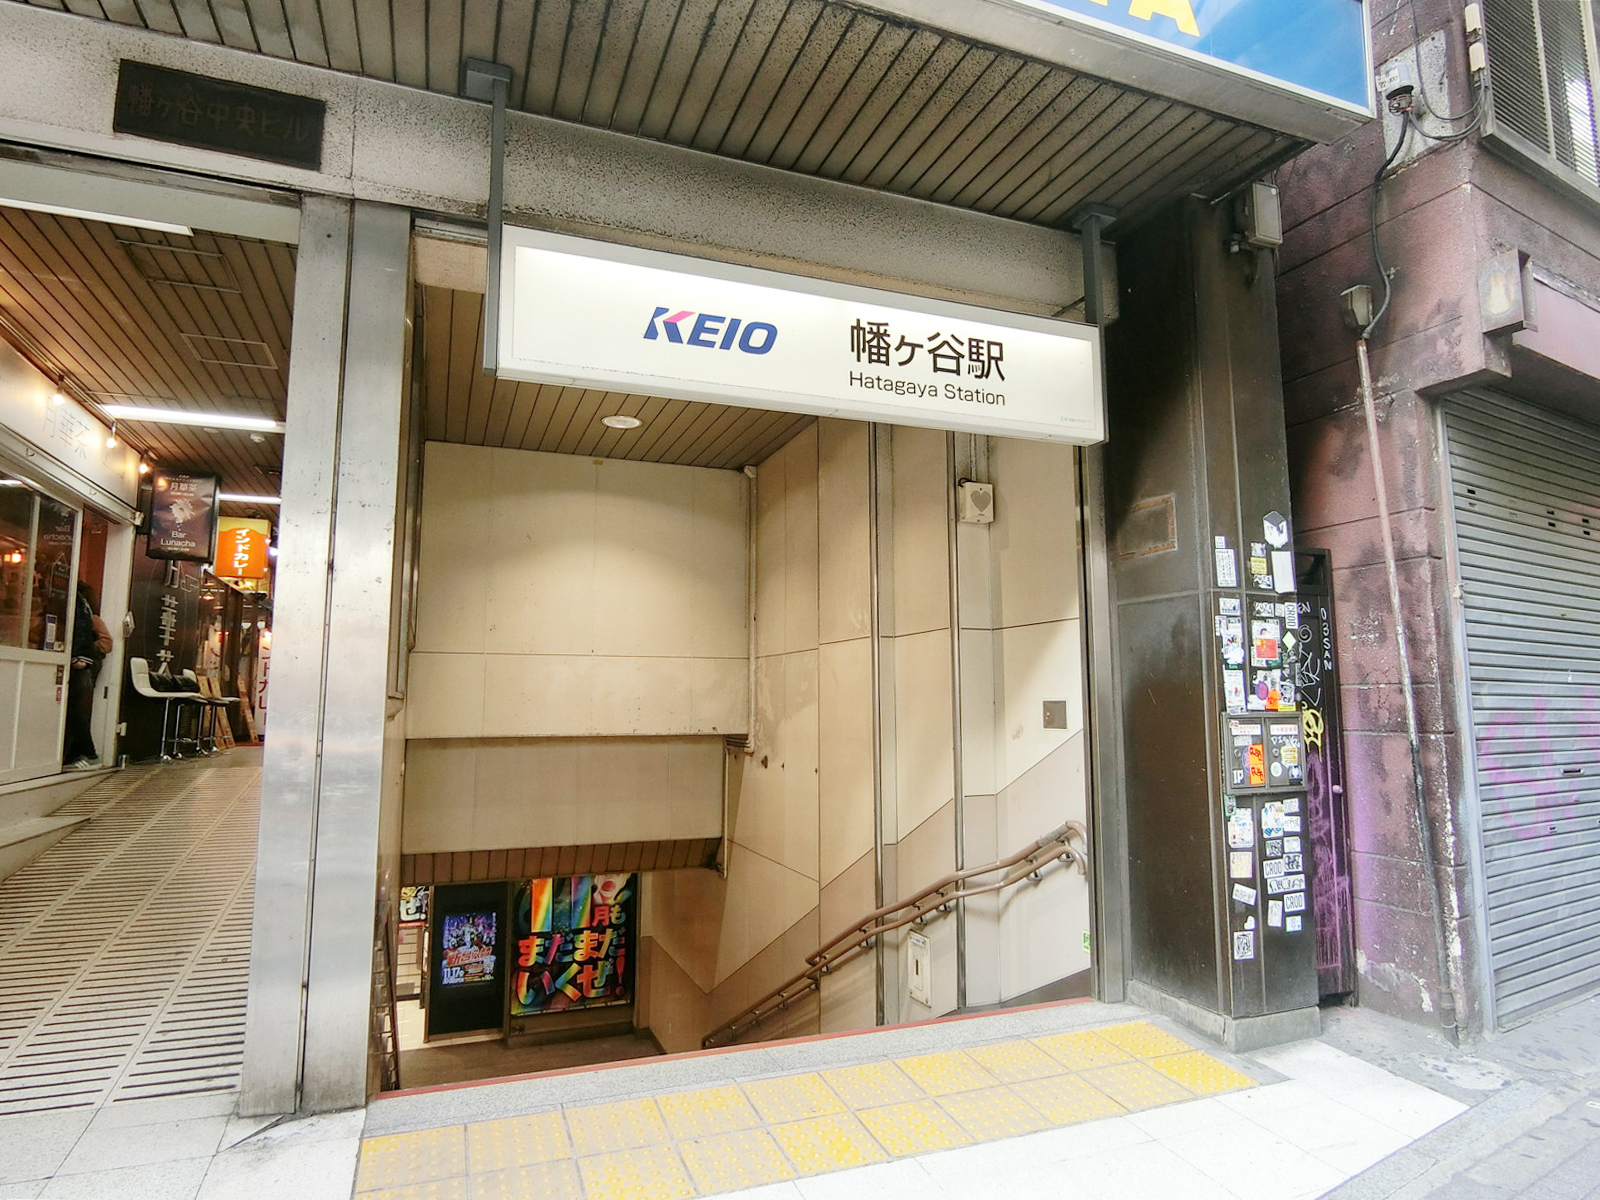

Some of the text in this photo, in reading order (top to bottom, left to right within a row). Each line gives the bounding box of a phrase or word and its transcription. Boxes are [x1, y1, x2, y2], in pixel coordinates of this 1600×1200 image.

[643, 306, 778, 356] KEIO
[850, 318, 1006, 382] 幡ヶ谷駅
[849, 370, 1006, 406] Hatagaya Station
[160, 538, 196, 548] Lunacha
[171, 530, 187, 539] Bar
[233, 528, 251, 576] インドカレー
[518, 927, 626, 966] まだまだ
[516, 955, 626, 1006] いくぜ!
